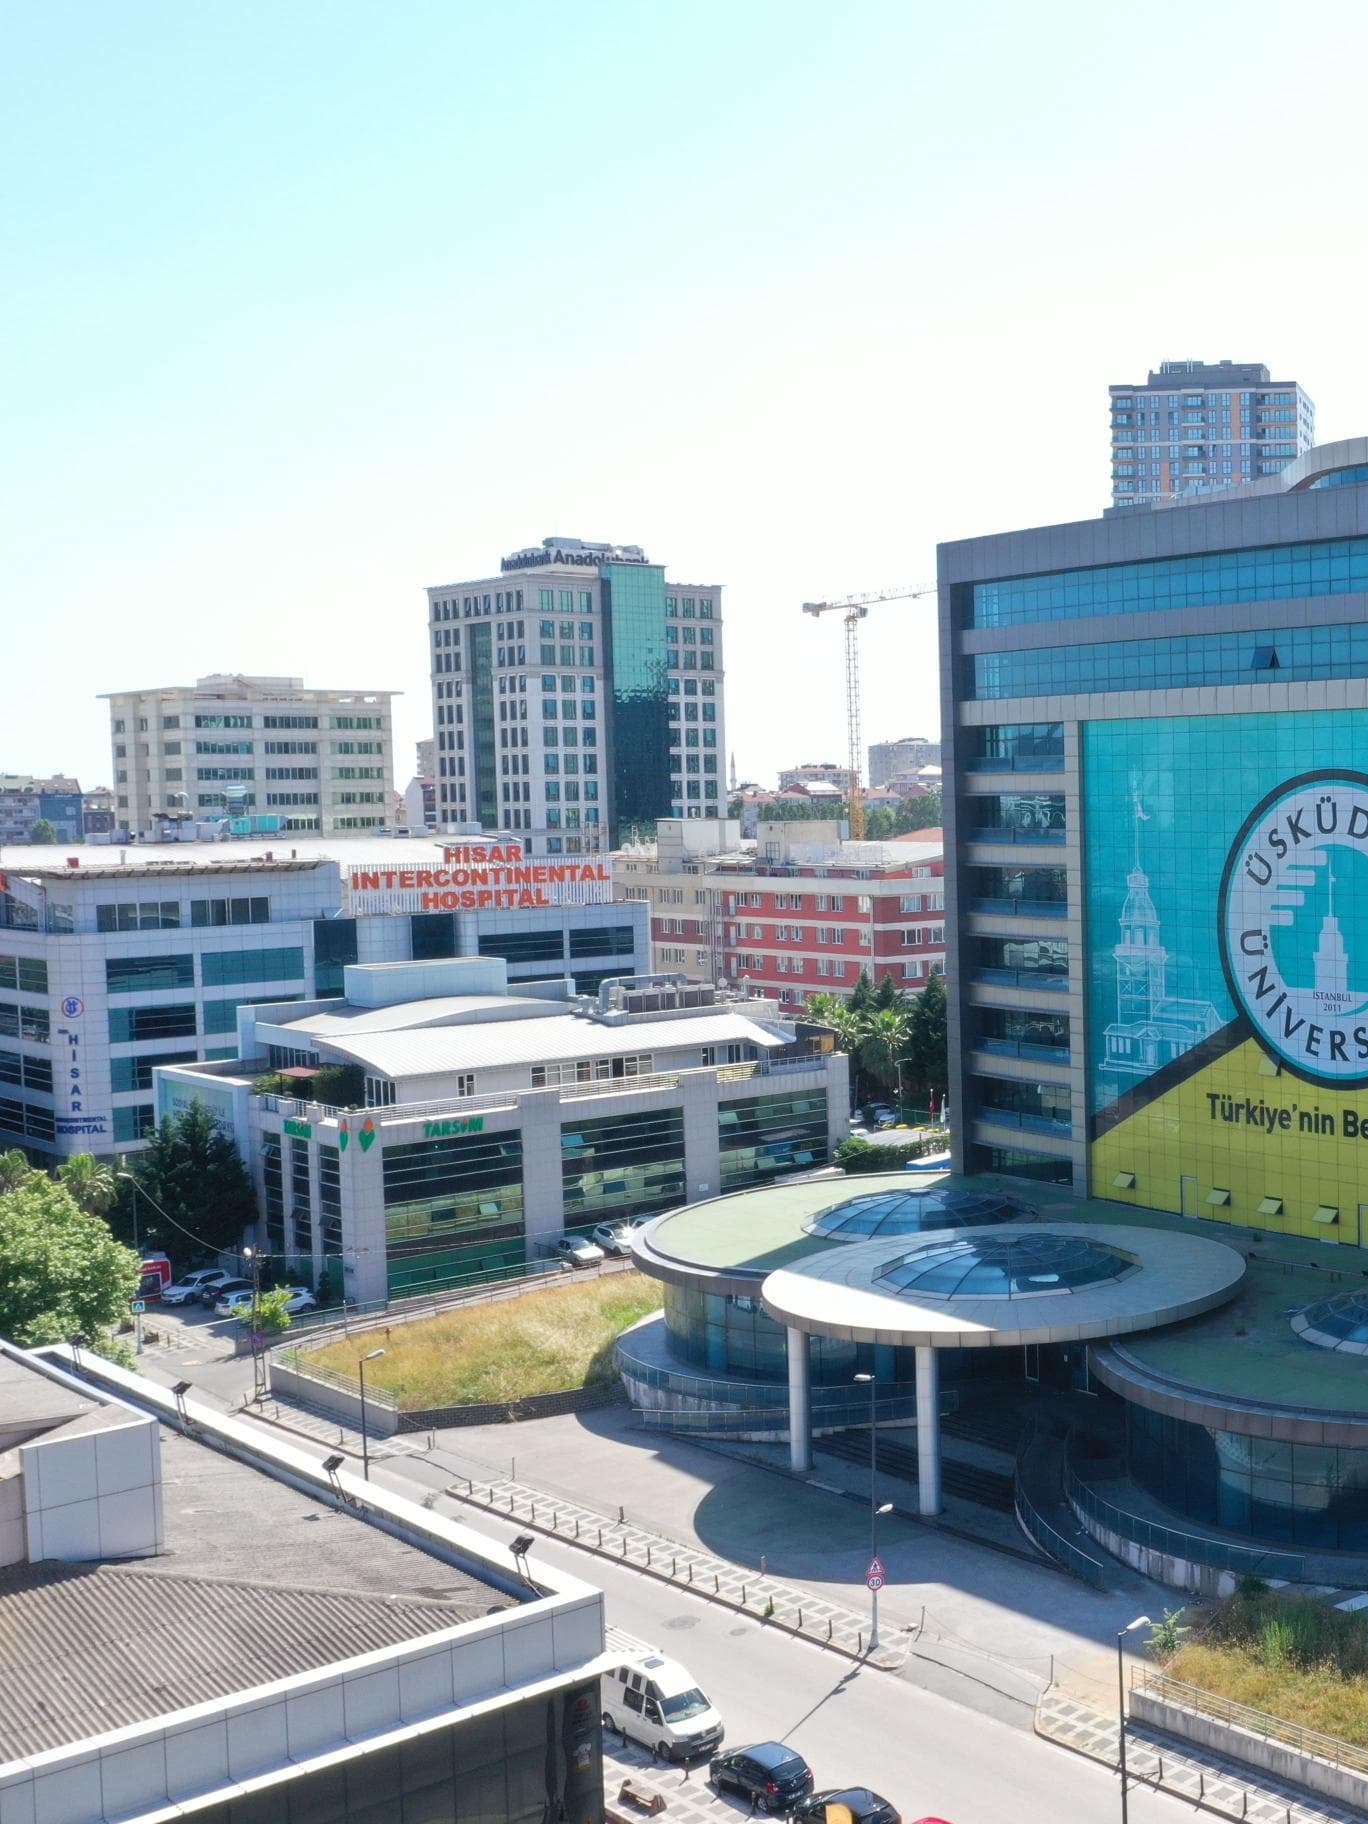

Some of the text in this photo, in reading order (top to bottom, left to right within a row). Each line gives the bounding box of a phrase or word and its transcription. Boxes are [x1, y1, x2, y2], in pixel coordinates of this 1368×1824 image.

[443, 845, 523, 865] HISAR
[352, 863, 611, 891] INTERCONTINENTAL
[422, 888, 551, 911] HOSPITAL
[1322, 1002, 1342, 1013] 2011
[870, 1578, 881, 1587] 30
